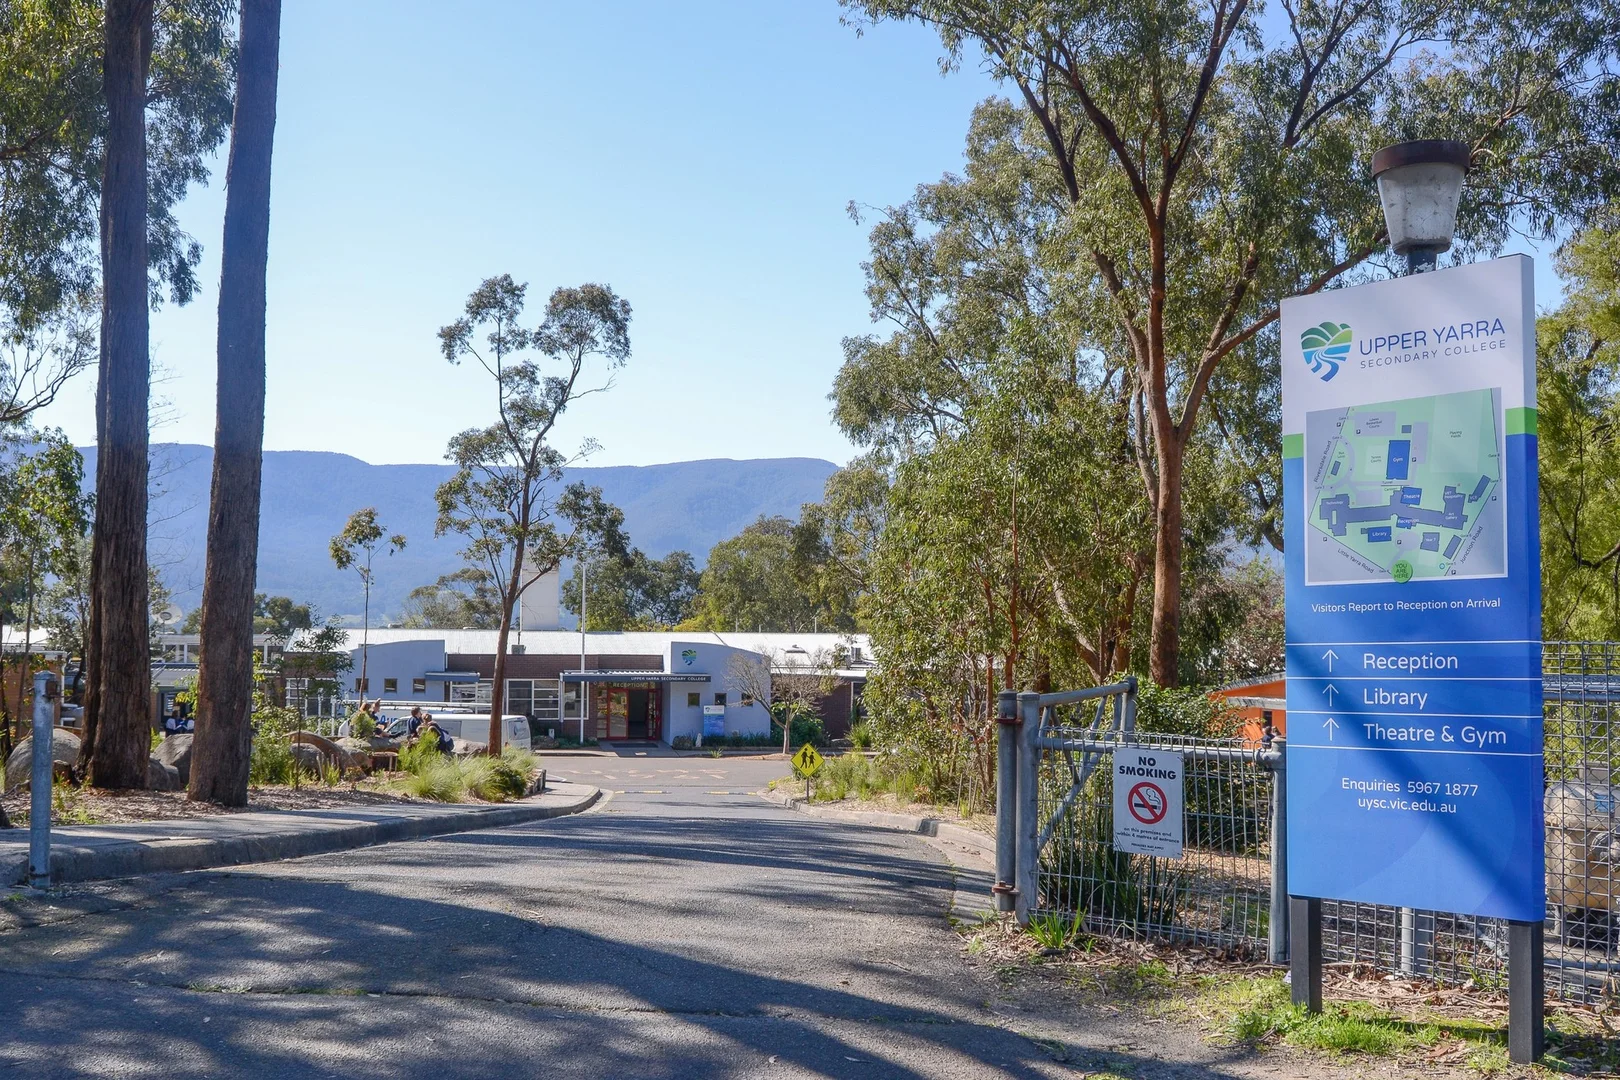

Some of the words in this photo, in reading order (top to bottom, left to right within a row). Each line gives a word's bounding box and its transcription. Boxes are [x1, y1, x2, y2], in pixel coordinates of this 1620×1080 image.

[1360, 330, 1427, 356] UPPER
[1433, 318, 1506, 344] YARRA
[1360, 350, 1438, 369] SECONDARY
[1444, 339, 1506, 357] COLLEGE
[1323, 440, 1331, 455] Road
[1472, 525, 1483, 541] Road
[1337, 548, 1349, 558] Little
[1350, 555, 1361, 566] Yarra
[1361, 562, 1375, 574] Road
[1311, 602, 1346, 613] Visitors
[1348, 602, 1381, 613] Report
[1383, 602, 1394, 611] to
[1396, 599, 1448, 612] Reception
[1450, 600, 1463, 609] on
[1466, 597, 1501, 608] Arrival
[1363, 653, 1458, 674] Reception
[1363, 688, 1428, 710] Library
[1363, 723, 1435, 742] Theatre
[1441, 725, 1455, 743] &
[1461, 726, 1507, 749] Gym
[1138, 756, 1156, 767] NO
[1118, 765, 1177, 780] SMOKING
[1341, 777, 1401, 793] Enquiries
[1407, 781, 1441, 794] 5967
[1444, 783, 1479, 797] 1877
[1358, 798, 1457, 814] uysc.vic.edu.au
